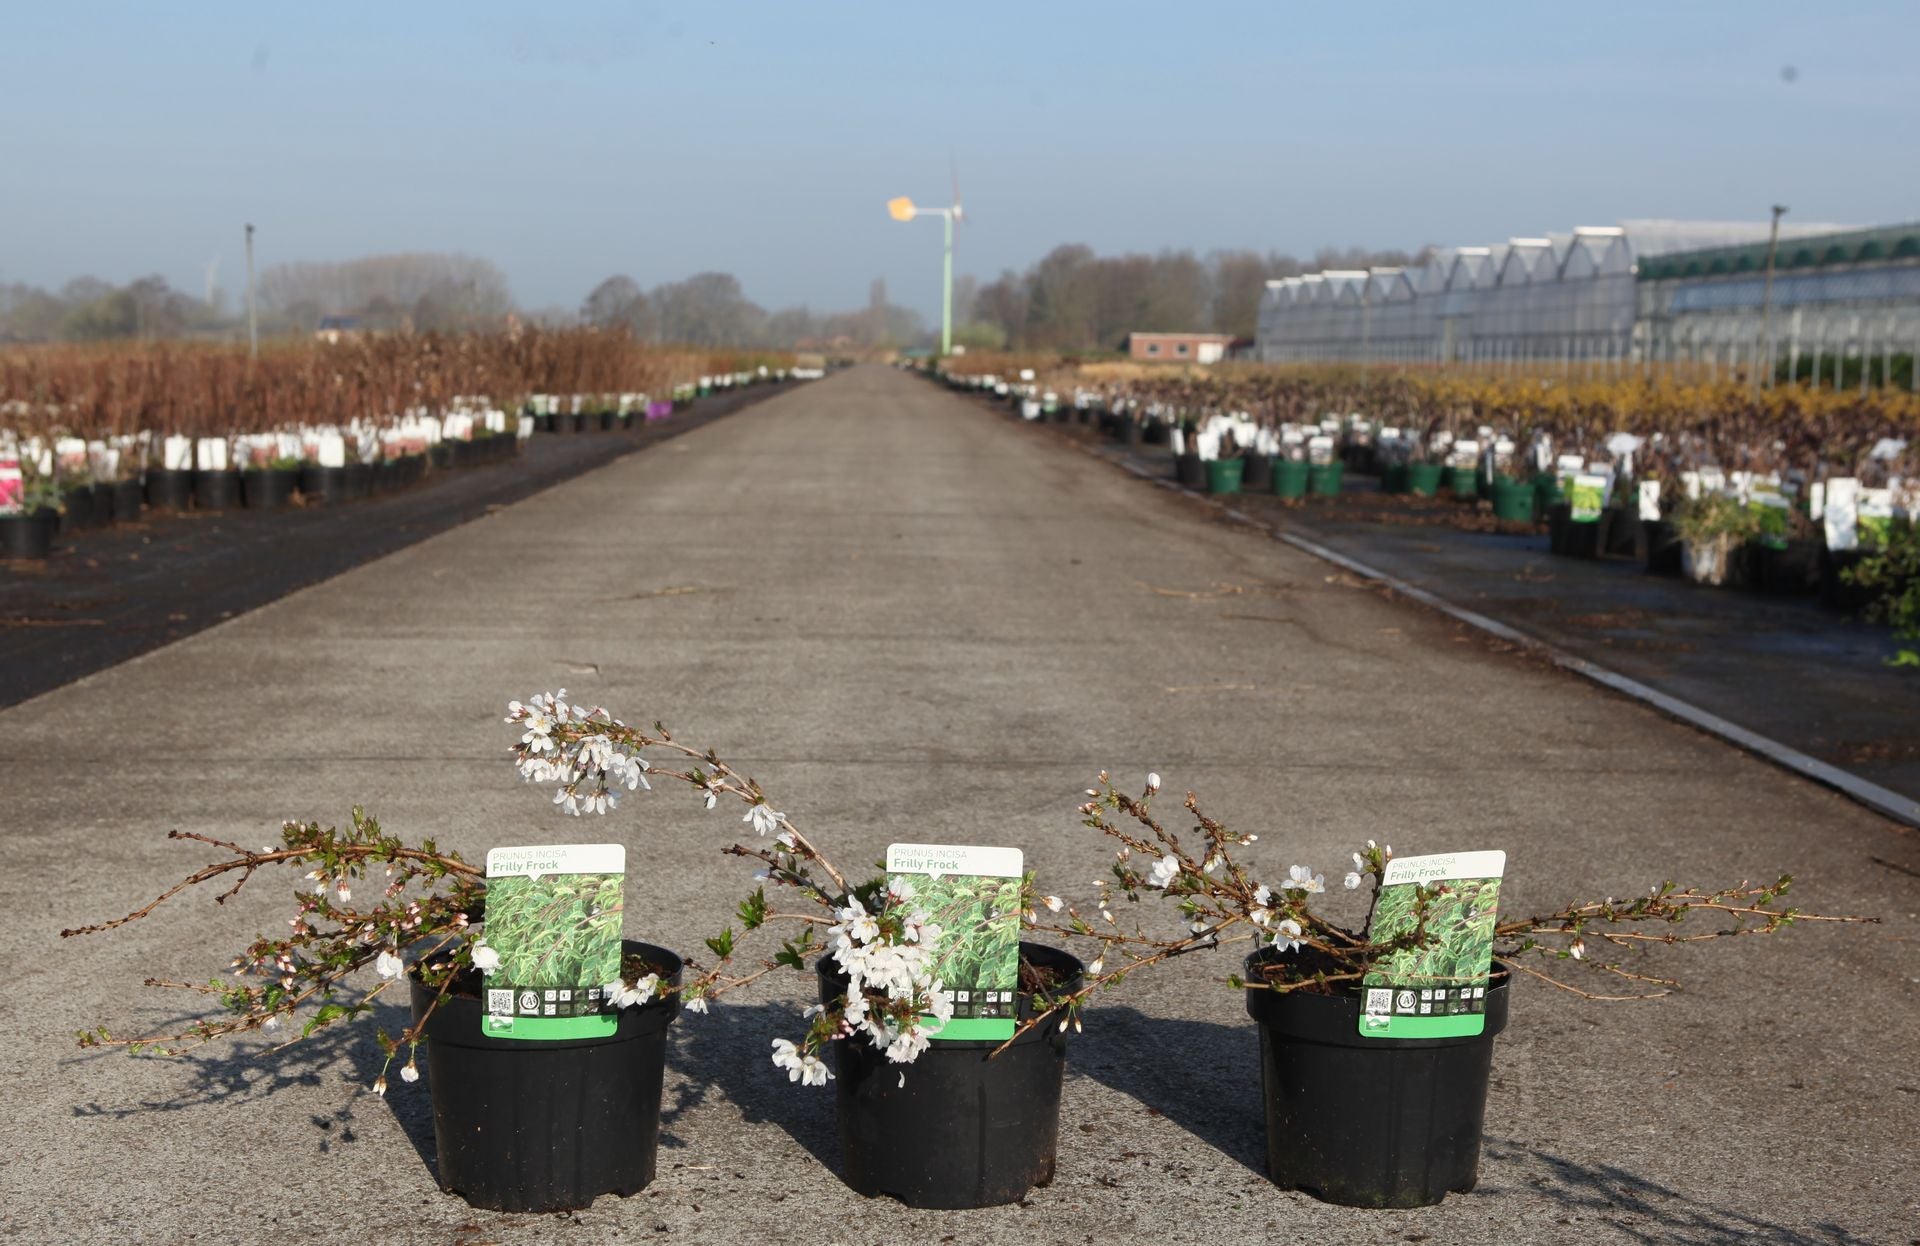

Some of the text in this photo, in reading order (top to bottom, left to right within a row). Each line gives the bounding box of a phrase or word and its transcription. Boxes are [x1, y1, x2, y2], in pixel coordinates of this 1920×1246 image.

[493, 850, 568, 861] PRUNUS INCISA
[894, 848, 967, 858] PRUNUS INCISA
[493, 860, 558, 872] Frilly Frock
[894, 858, 959, 870] Frilly Frock
[1393, 857, 1456, 869] PRUNUS INCISA
[1390, 868, 1446, 881] Frilly Frock
